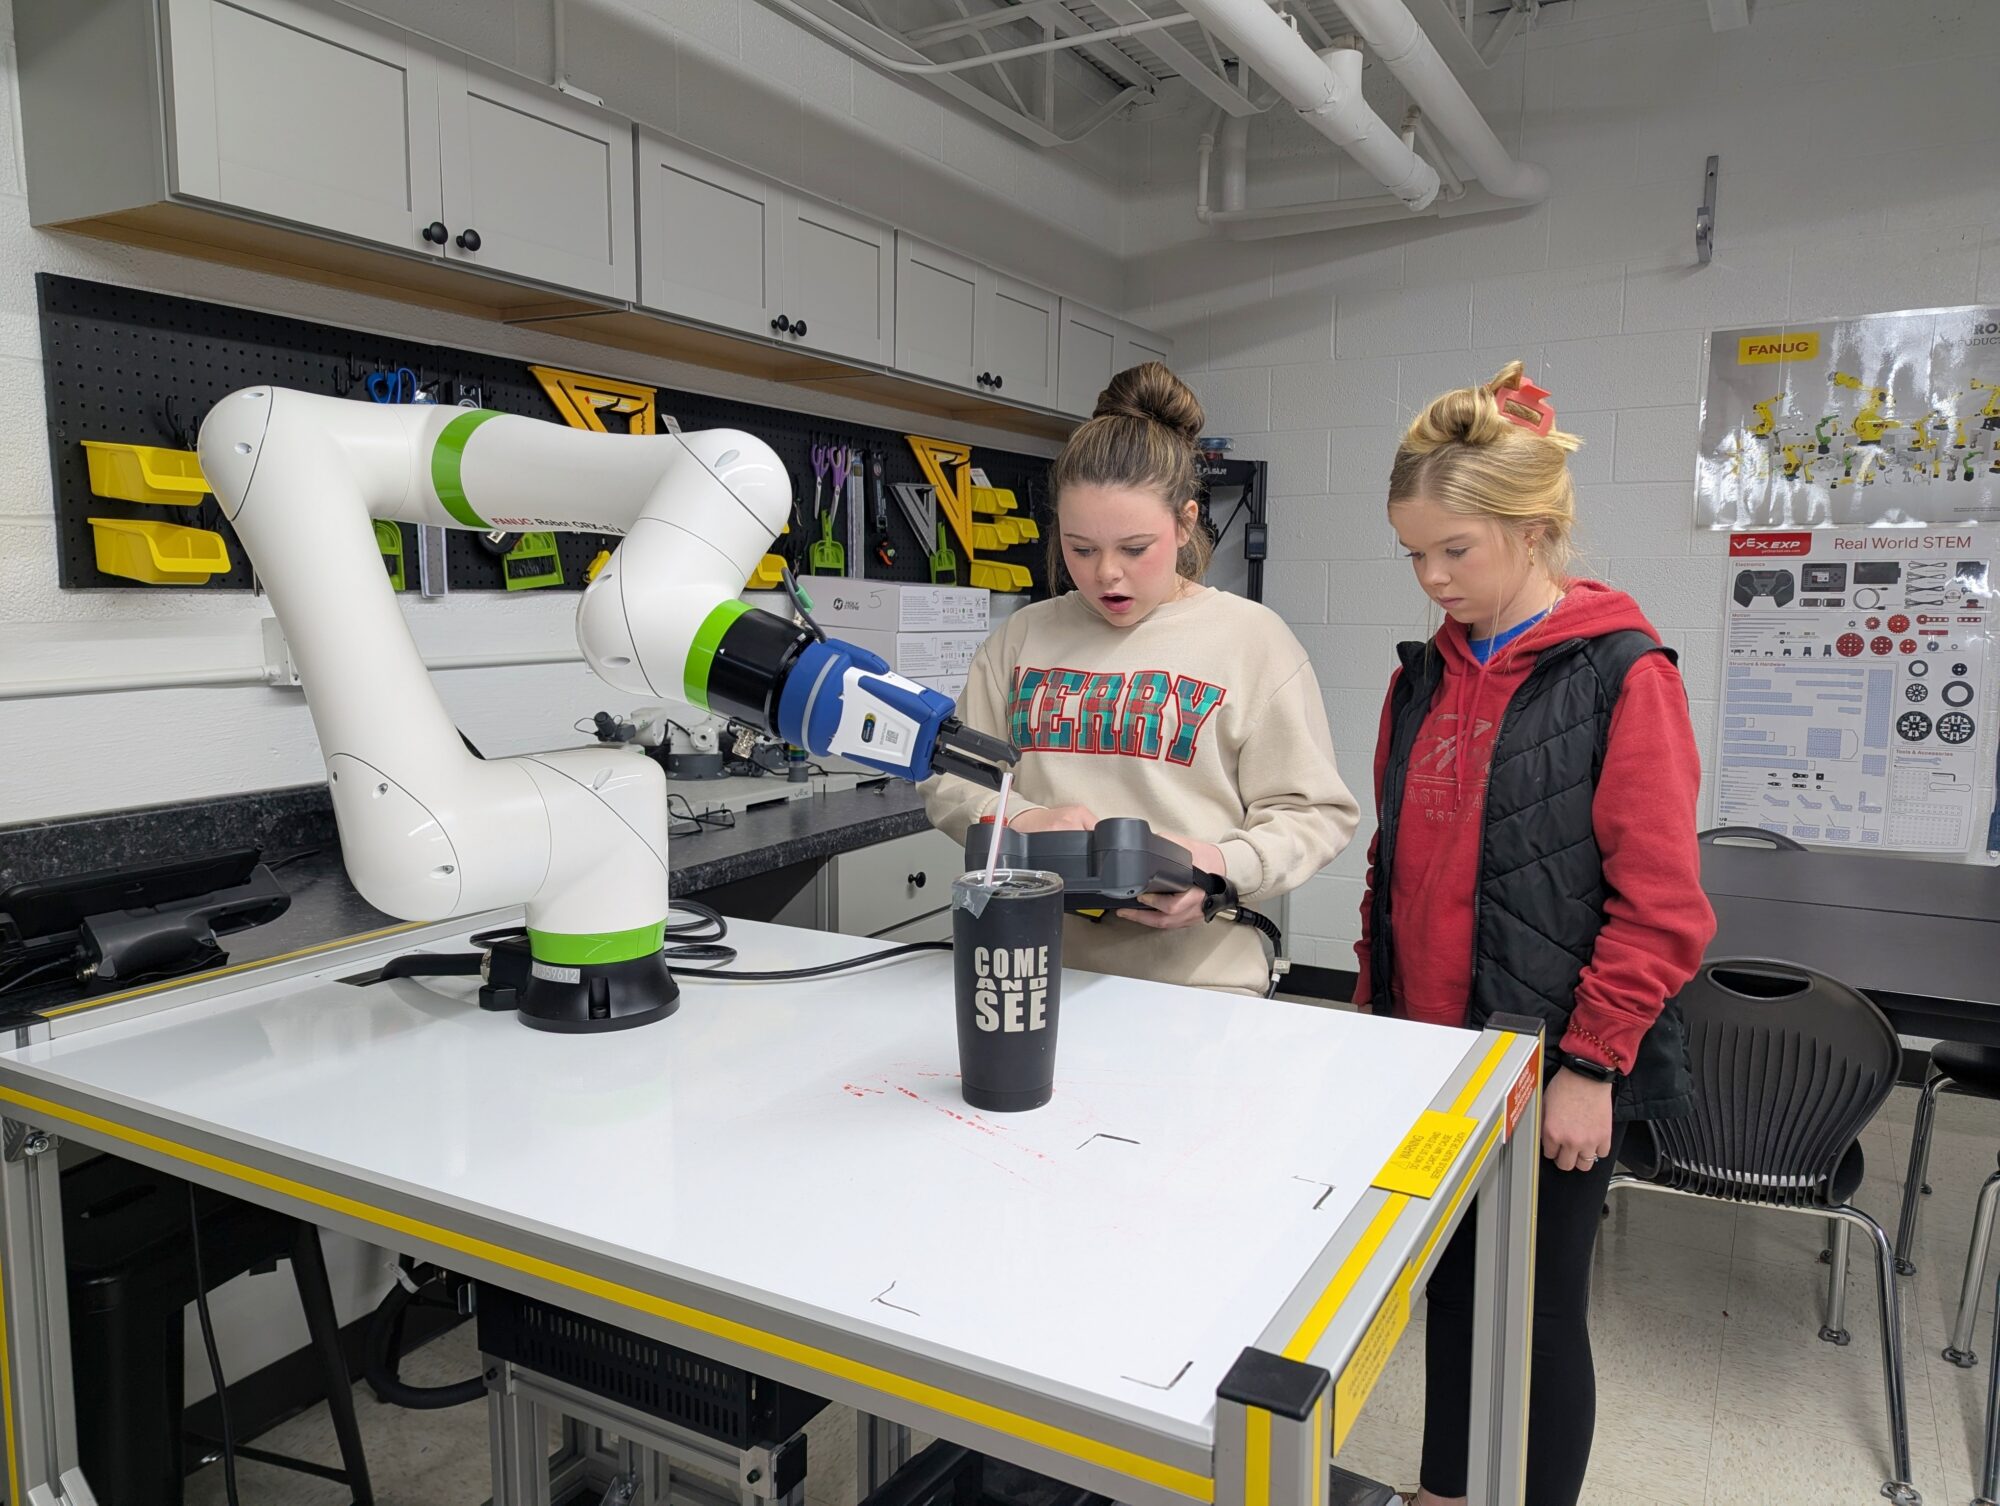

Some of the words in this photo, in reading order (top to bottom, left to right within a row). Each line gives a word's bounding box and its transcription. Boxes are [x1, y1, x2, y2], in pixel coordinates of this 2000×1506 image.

[1974, 323, 2000, 335] RO
[1748, 341, 1809, 356] FANUC
[490, 517, 533, 526] FANUC
[534, 518, 572, 527] Robot
[1733, 538, 1769, 550] VEX
[1770, 541, 1800, 549] EXP
[1834, 537, 1867, 550] Real
[1871, 536, 1919, 550] World
[1922, 535, 1972, 549] STEM
[867, 589, 888, 609] 5
[975, 945, 1048, 979] COME
[976, 977, 1048, 992] AND
[975, 989, 1047, 1033] SEE
